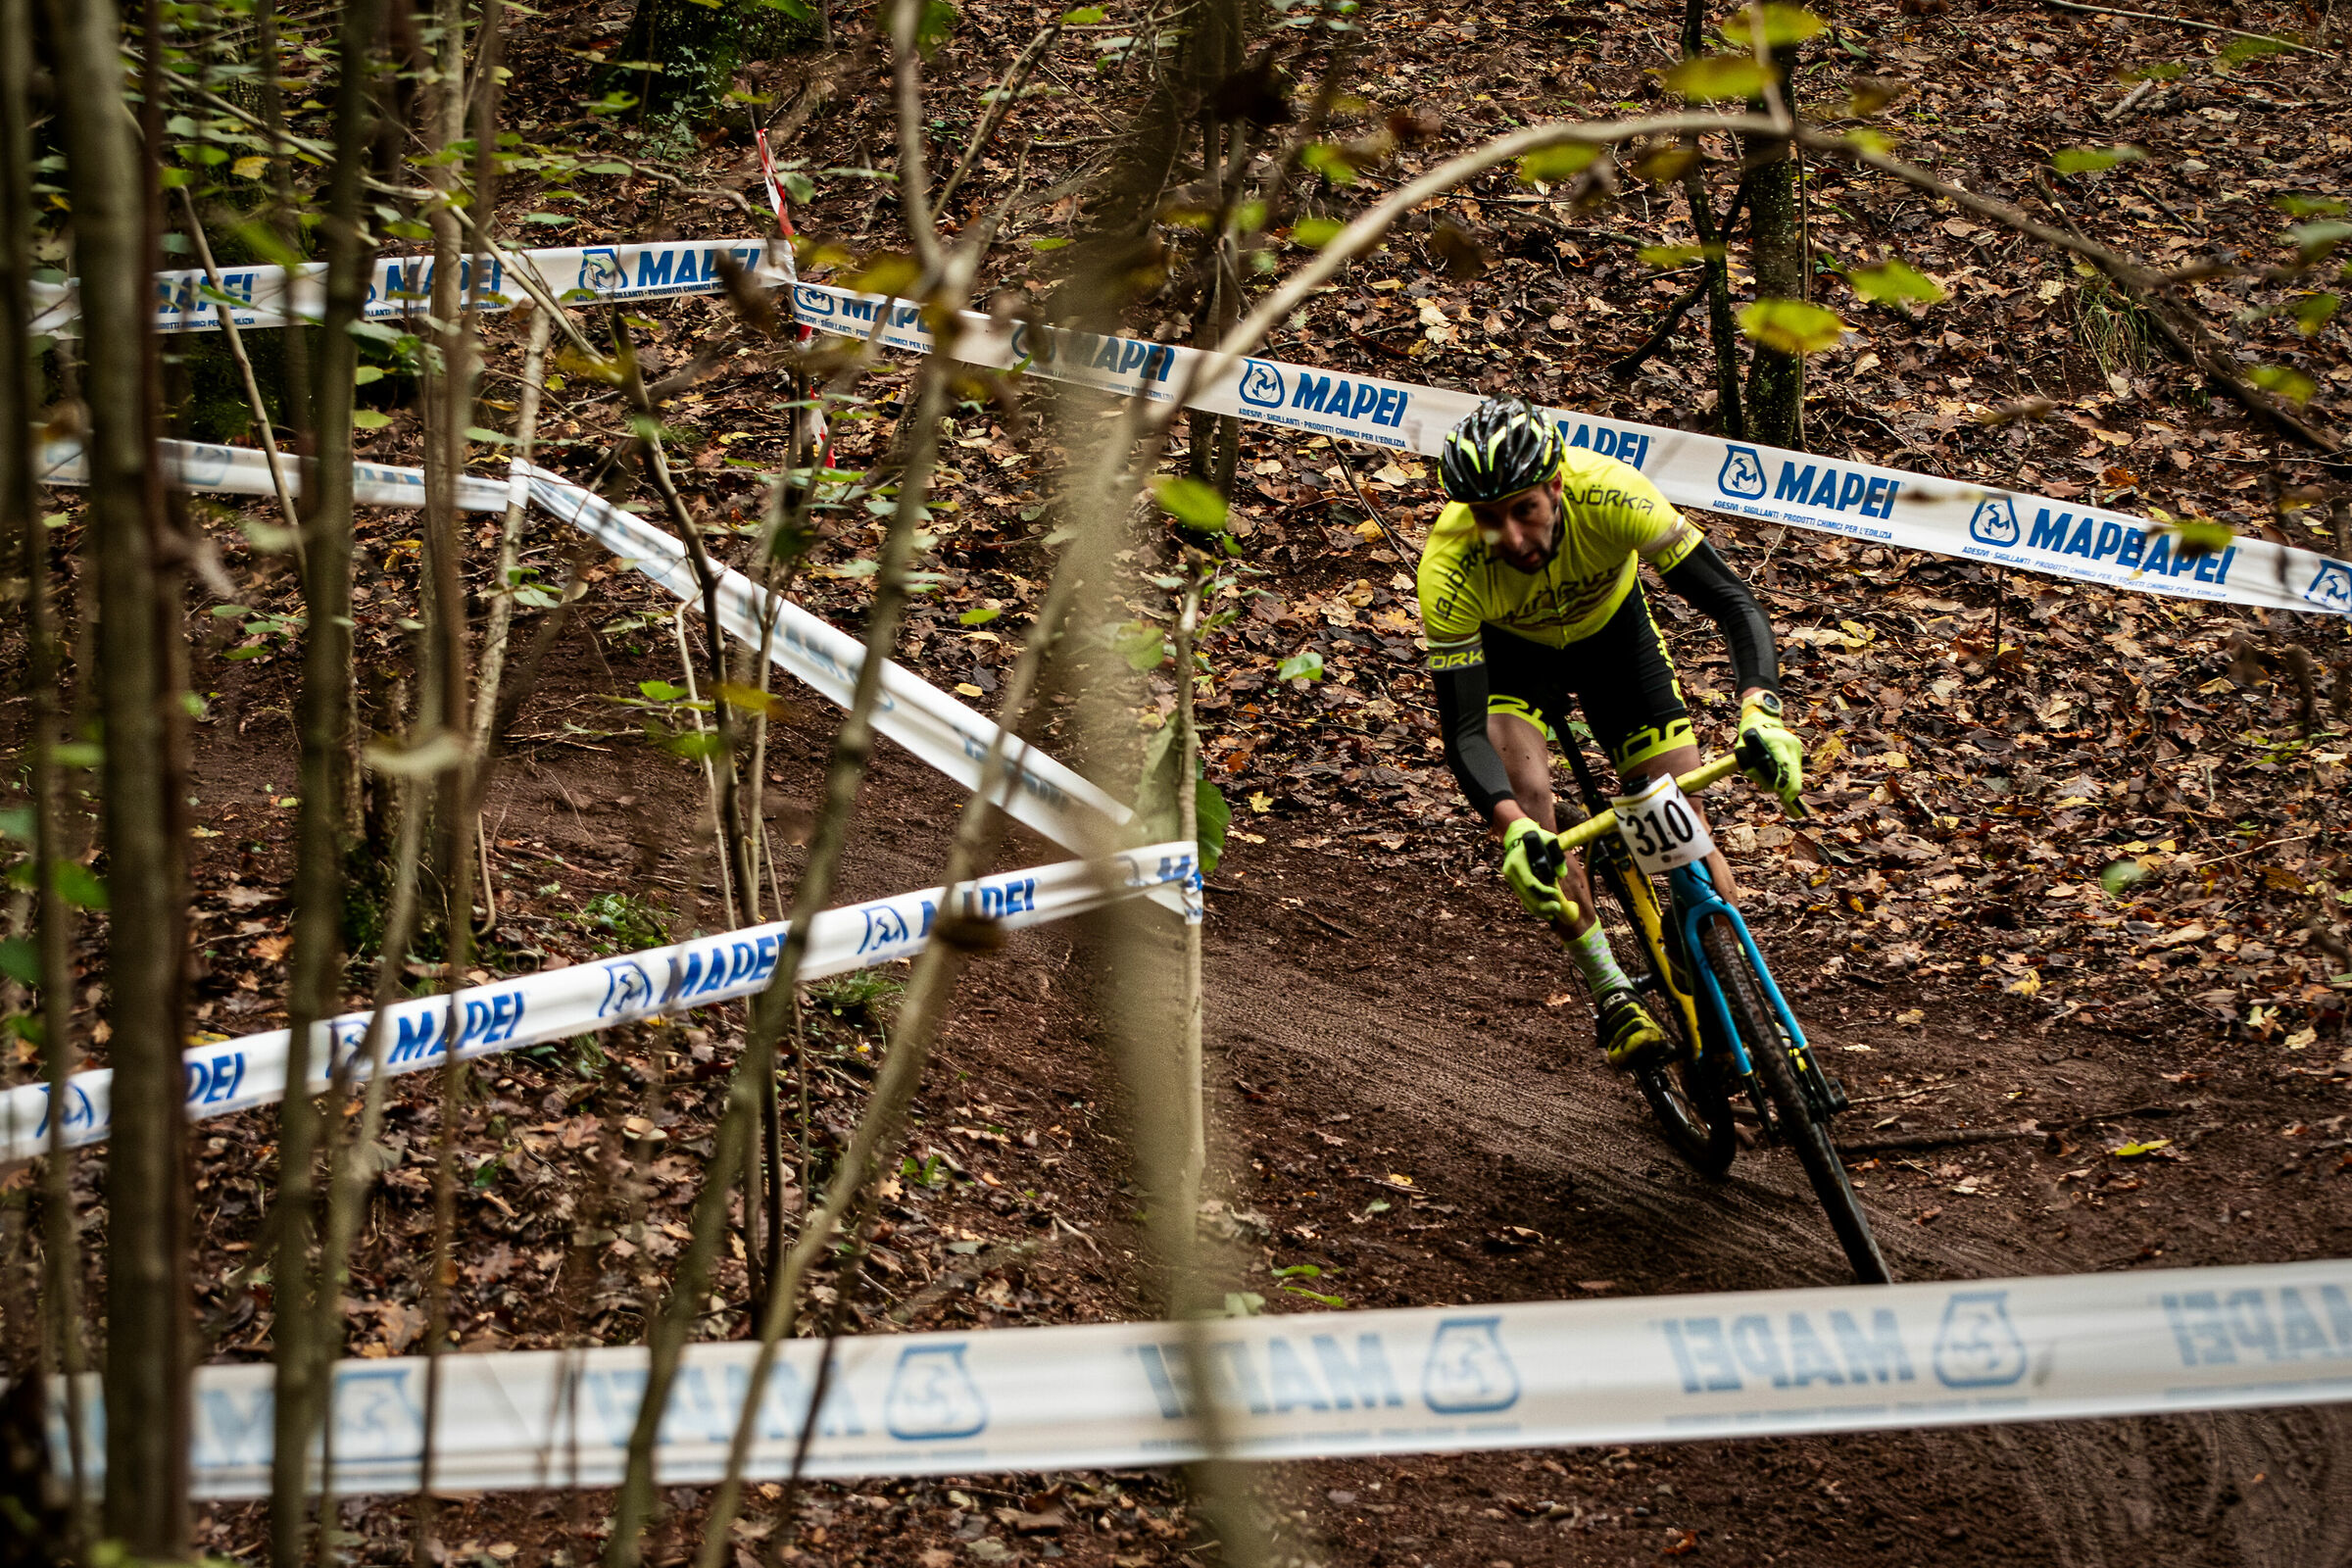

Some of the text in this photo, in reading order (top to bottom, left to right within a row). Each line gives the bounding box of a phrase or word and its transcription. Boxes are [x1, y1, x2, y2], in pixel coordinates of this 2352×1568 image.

[1292, 372, 1408, 427] MAPEI
[1239, 408, 1406, 448] ADESIVI SIGILLANTI PRODOTTI CHIMICI PER L'EDILIZIA
[1774, 461, 1900, 519] MAPEI
[1712, 500, 1892, 540] ADESIVI SIGILLANTI PRODOTTI CHIMICI PER L'EDILIZIA
[1962, 546, 1989, 558] ADESIVI
[1993, 552, 2031, 565] SIGILLANTI
[2034, 560, 2068, 572] PRODOTTI
[2097, 572, 2112, 581] PER
[1626, 800, 1693, 857] 310
[183, 1052, 245, 1104] PEI
